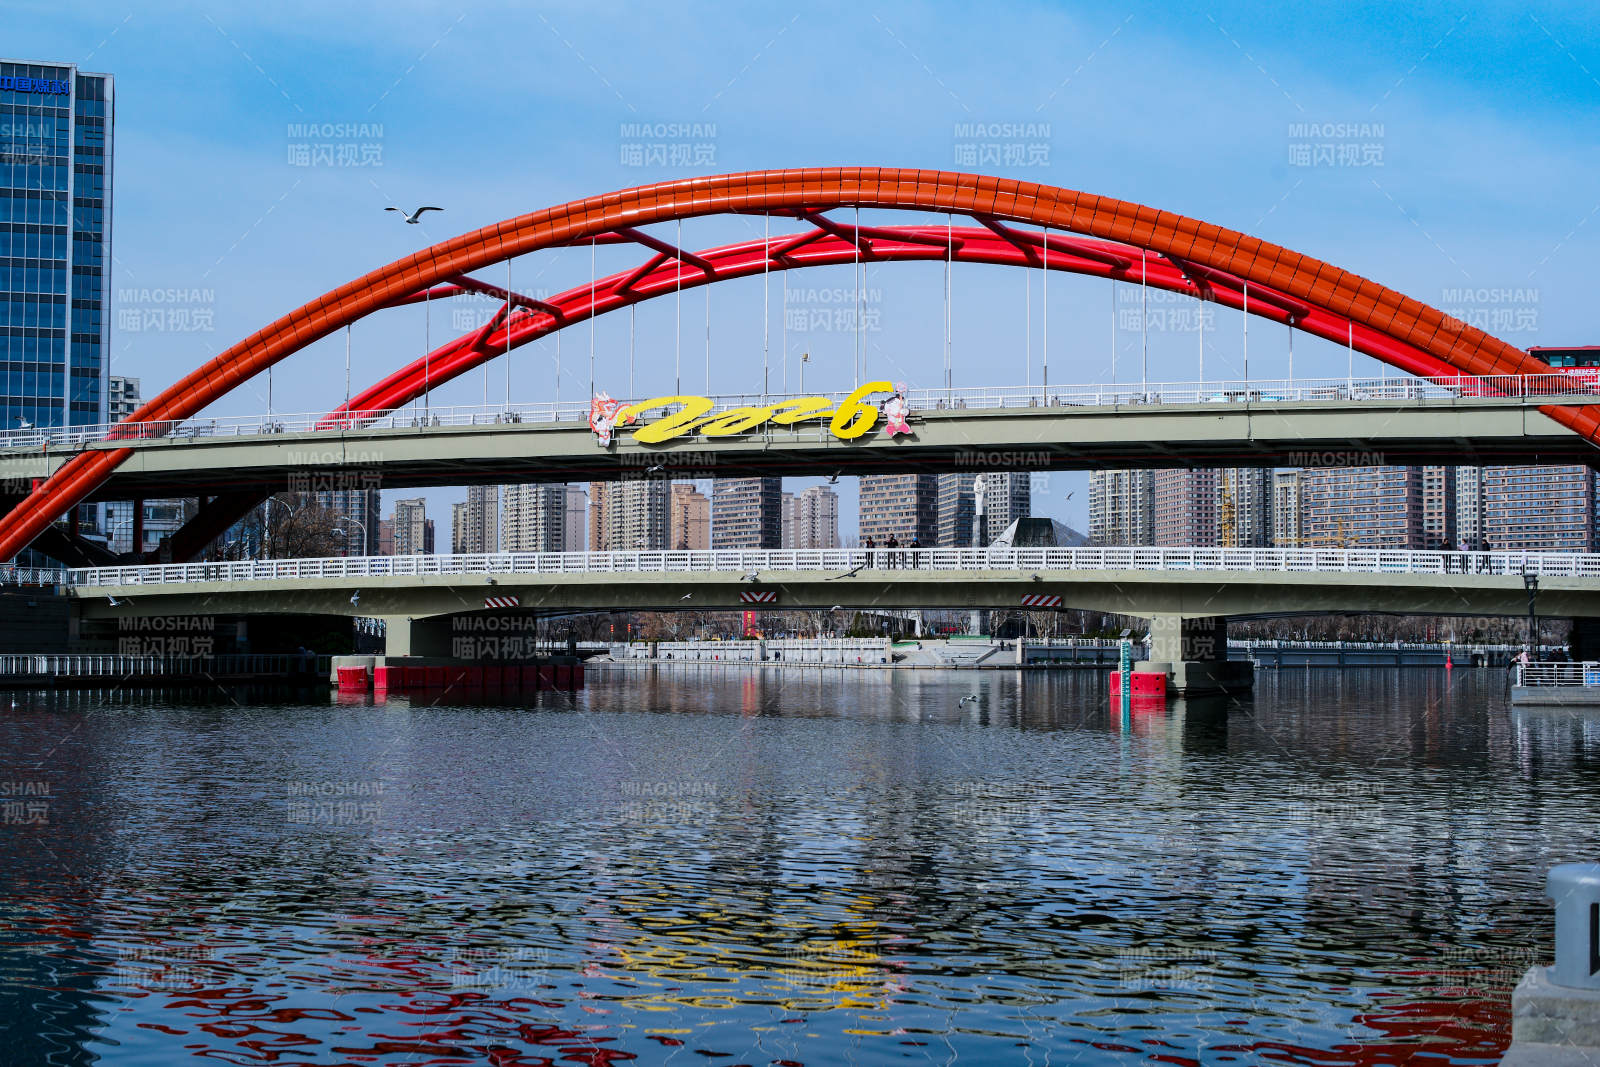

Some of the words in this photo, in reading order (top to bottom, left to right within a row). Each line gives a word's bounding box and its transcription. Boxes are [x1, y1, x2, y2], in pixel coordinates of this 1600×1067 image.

[0, 75, 70, 95] 中国煤科
[613, 381, 894, 444] 2026
